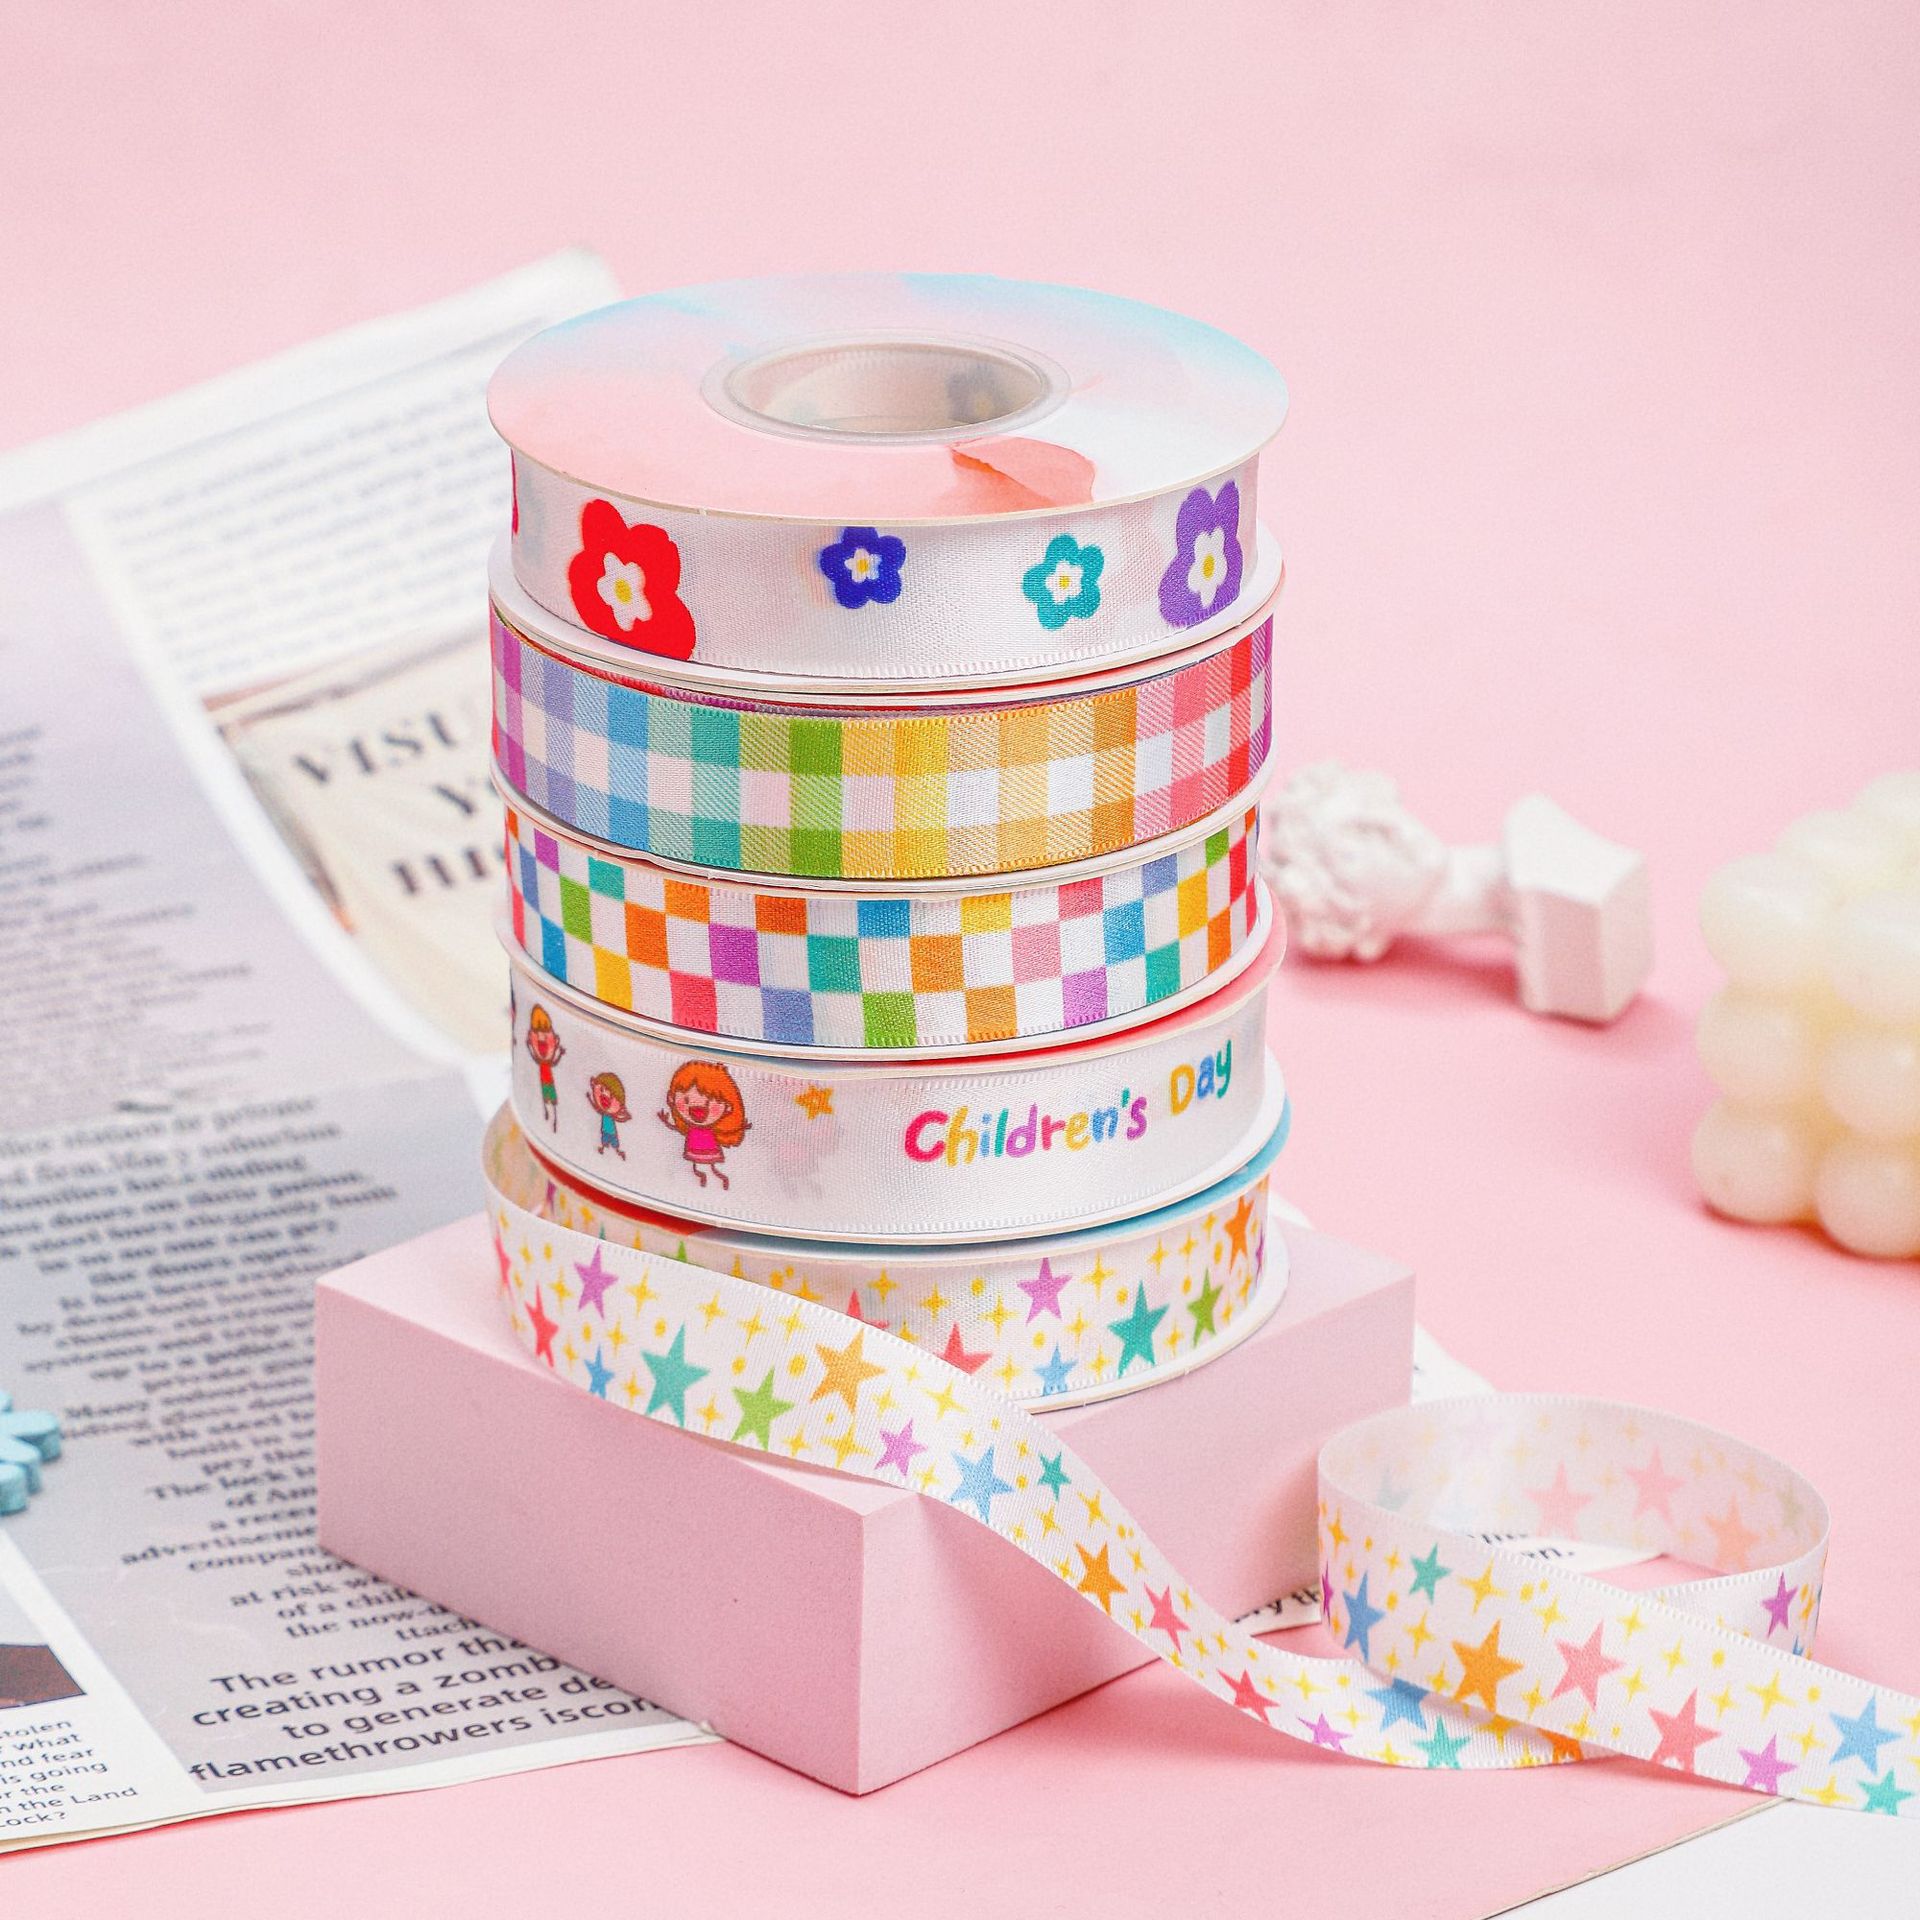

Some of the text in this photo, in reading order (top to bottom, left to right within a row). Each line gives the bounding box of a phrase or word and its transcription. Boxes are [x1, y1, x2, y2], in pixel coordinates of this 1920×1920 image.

[904, 1039, 1232, 1168] Children's Day
[277, 1603, 308, 1619] of
[285, 1621, 340, 1639] the
[210, 1673, 299, 1694] The
[310, 1646, 445, 1682] rumor
[192, 1687, 383, 1727] creating
[396, 1681, 422, 1696] a
[281, 1721, 332, 1740] to
[344, 1686, 548, 1734] generate
[0, 1720, 72, 1739] tolen
[13, 1733, 82, 1751] what
[188, 1716, 532, 1781] flamethrowers
[41, 1748, 93, 1764] fear
[30, 1761, 108, 1782] going
[18, 1799, 64, 1811] the
[70, 1787, 138, 1805] Land
[20, 1785, 65, 1796] the
[0, 1810, 66, 1828] ock?
